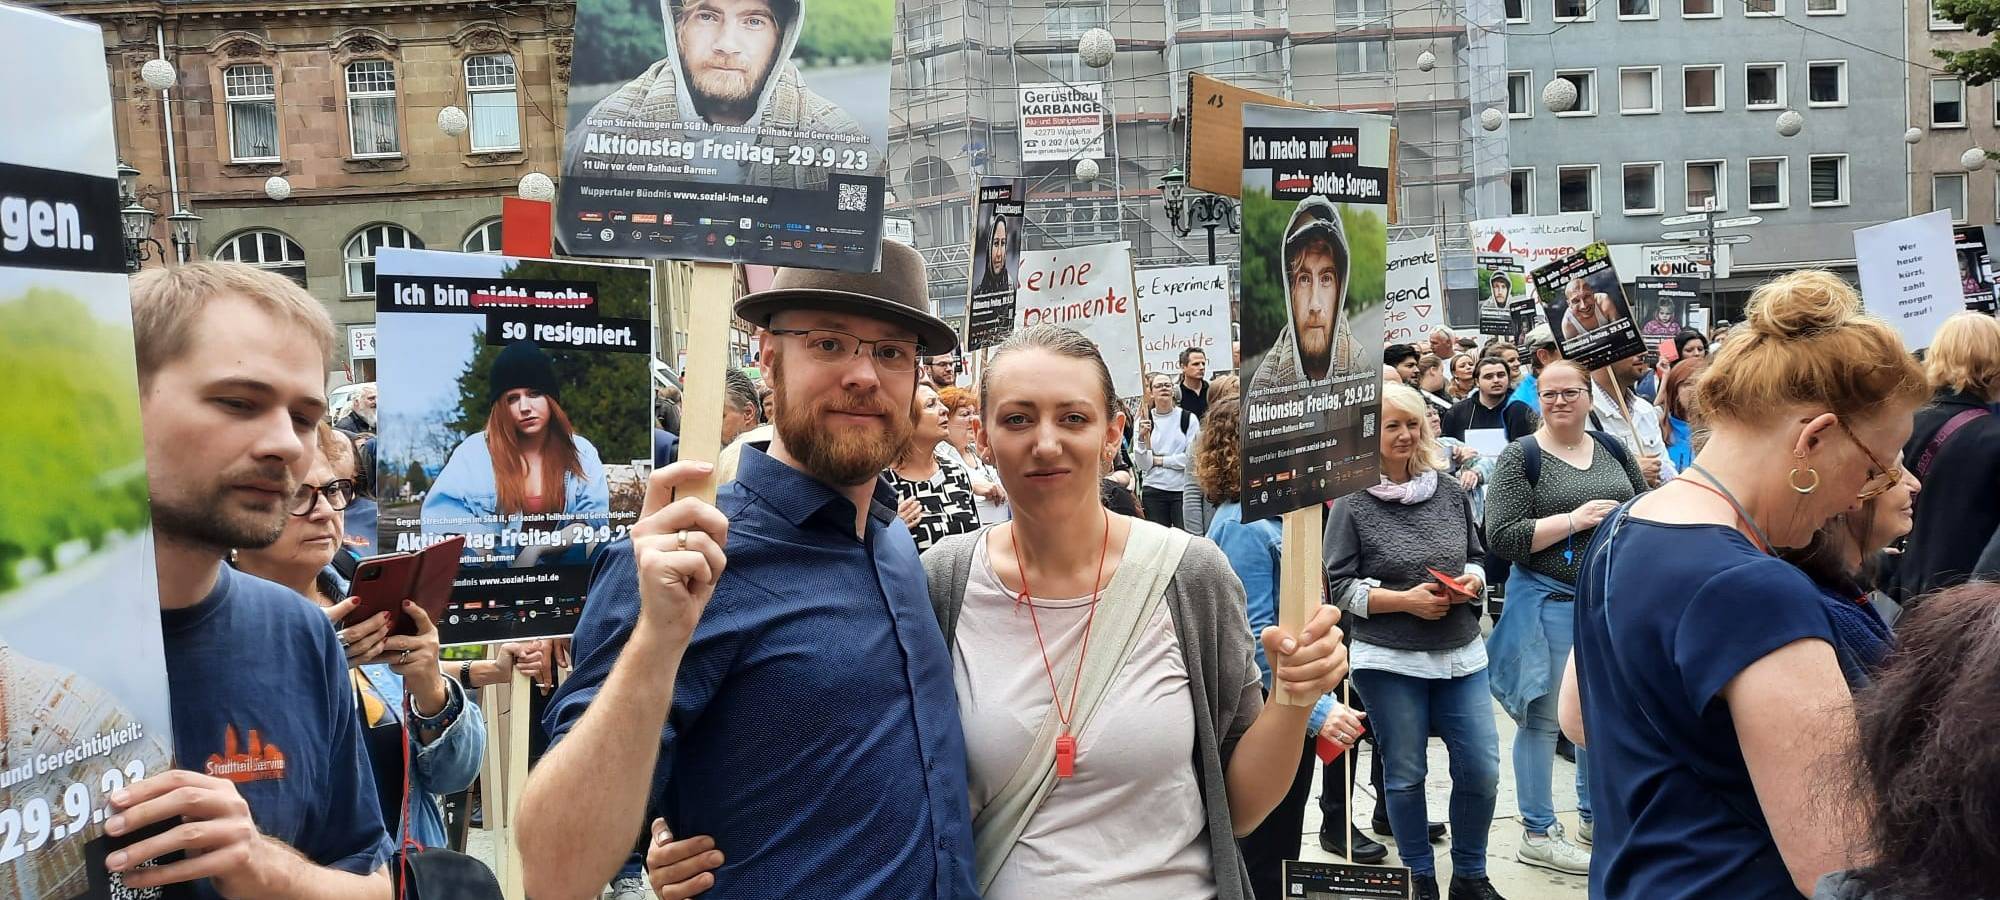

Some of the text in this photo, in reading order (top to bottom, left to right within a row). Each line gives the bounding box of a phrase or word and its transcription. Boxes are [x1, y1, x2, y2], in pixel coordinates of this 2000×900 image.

[1024, 89, 1098, 103] Gerüstbau
[1022, 103, 1101, 115] KARBANGE
[586, 117, 613, 128] Gegen
[614, 118, 671, 131] Streichungen
[672, 122, 682, 130] im
[684, 122, 701, 131] SGB
[713, 123, 724, 132] für
[726, 125, 756, 134] soziale
[758, 126, 792, 138] Teilhabe
[794, 130, 810, 139] und
[811, 130, 870, 144] Gerechtigkeit:
[584, 133, 868, 171] Aktionstag Freitag, 29.9.23
[1249, 136, 1266, 160] Ich
[1269, 136, 1307, 160] mache
[1310, 136, 1329, 159] mir
[582, 160, 594, 170] 11
[594, 161, 610, 171] Uhr
[626, 162, 646, 172] dem
[647, 163, 682, 174] Rathaus
[683, 165, 717, 175] Barmen
[1312, 171, 1345, 195] solche
[1346, 172, 1381, 199] Sorgen.
[580, 186, 769, 205] Wuppertaler Bündnis www.sozial-im-tal.de
[1, 196, 94, 253] gen.
[1898, 243, 1917, 252] Wer
[1896, 255, 1923, 266] heute
[393, 282, 426, 306] Ich
[434, 284, 469, 307] bin
[1152, 275, 1226, 296] Experimente
[1903, 281, 1926, 292] zahlt
[1898, 293, 1933, 306] morgen
[1168, 304, 1213, 324] Jugend
[1903, 308, 1928, 319] drauf
[502, 321, 637, 347] so resigniert.
[1248, 383, 1375, 425] Aktionstag Freitag, 29.9.23
[396, 518, 420, 528] Gegen
[519, 513, 545, 522] soziale
[546, 512, 575, 521] Teilhabe
[576, 512, 588, 520] und
[396, 532, 495, 552] Aktiotag
[501, 528, 567, 547] Freitag,
[459, 554, 515, 564] athaus Barmen
[479, 573, 560, 586] www.sozial-im-tal.de
[0, 722, 143, 789] und Gerechtigkeit:
